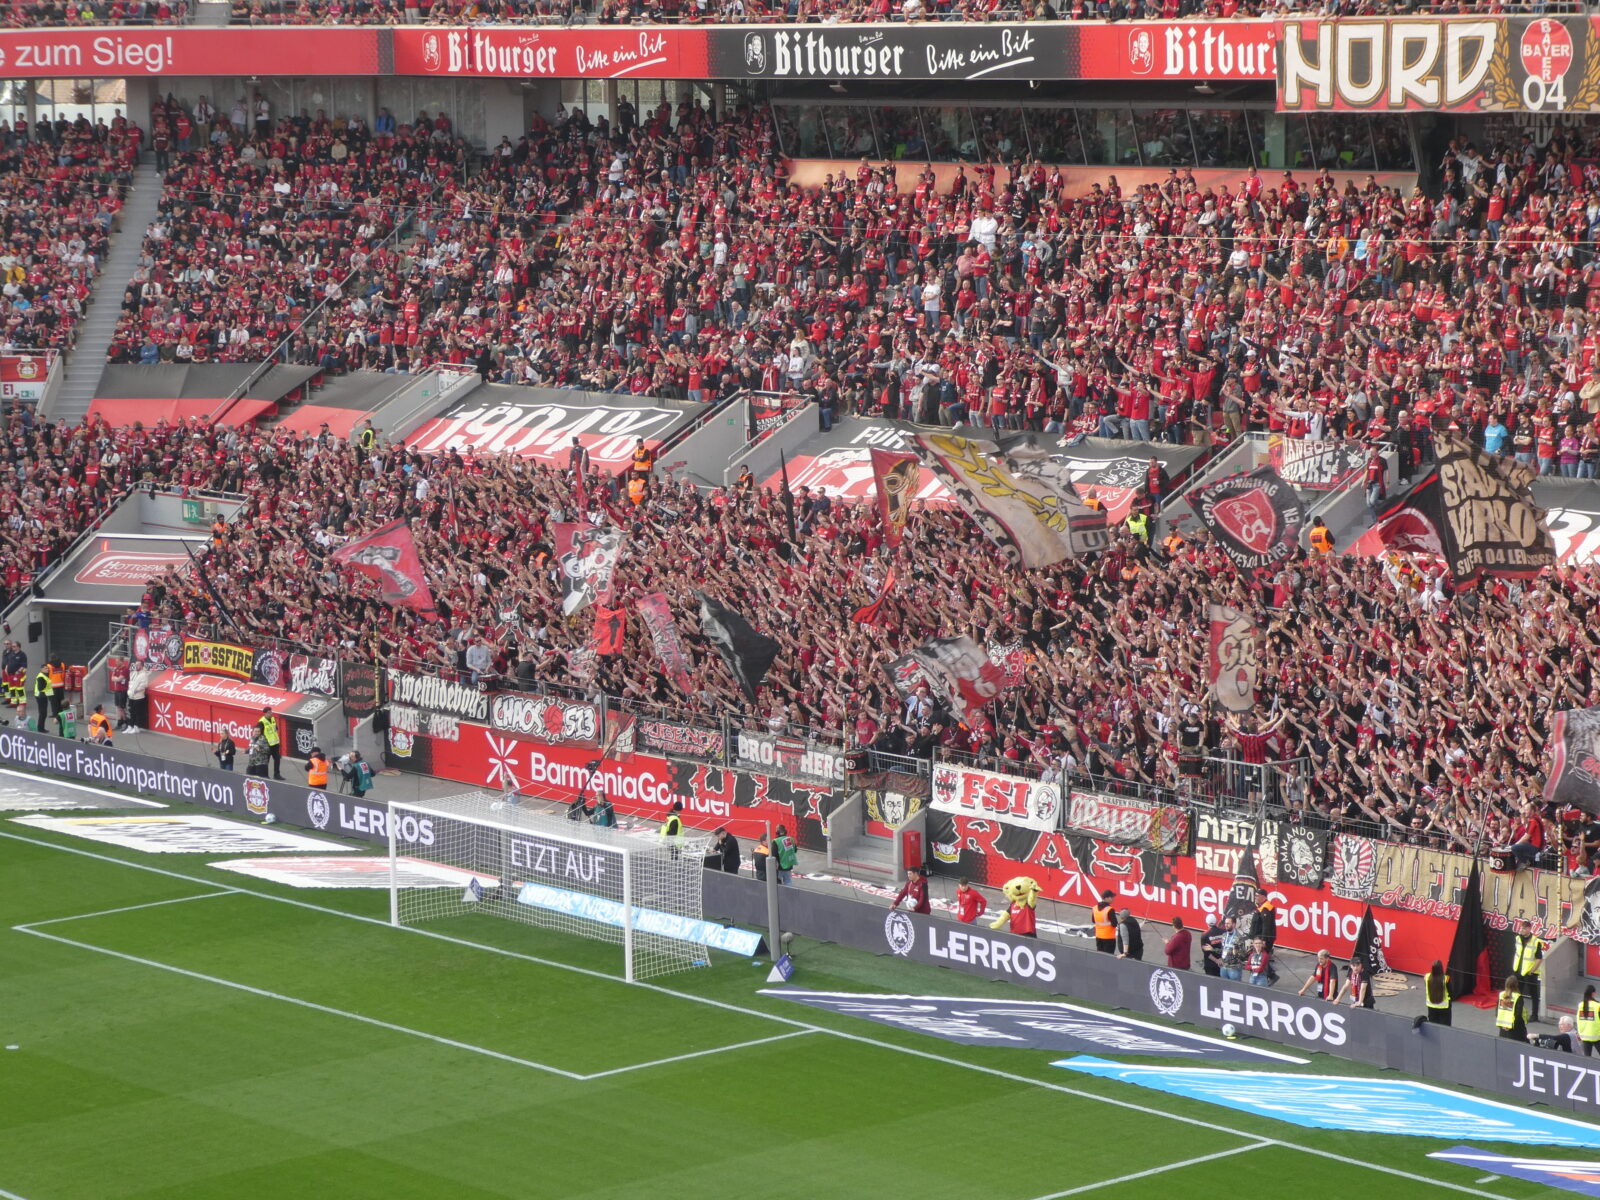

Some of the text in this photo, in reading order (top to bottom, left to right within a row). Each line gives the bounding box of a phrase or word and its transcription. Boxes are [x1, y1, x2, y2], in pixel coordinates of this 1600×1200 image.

[15, 45, 82, 66] zum
[93, 37, 173, 72] Sieg!
[612, 49, 638, 63] ein
[639, 32, 667, 59] Bit
[774, 31, 904, 75] Bitburger
[970, 44, 999, 64] ein
[1001, 29, 1034, 57] Bit
[1164, 26, 1277, 75] Bitbur
[1283, 21, 1498, 106] NORD
[1523, 45, 1570, 56] BAYER
[1541, 21, 1551, 81] BAYER
[1523, 75, 1567, 111] 04
[0, 734, 234, 806] Offizieller Fashionpartner von
[961, 772, 1032, 817] FSI
[339, 803, 435, 846] LERROS
[565, 850, 606, 883] AUF
[1196, 846, 1261, 876] BOY
[1280, 827, 1315, 880] COMMANDO
[929, 926, 1056, 982] LERROS
[1200, 986, 1347, 1046] LERROS
[1513, 1054, 1600, 1105] JETZT
